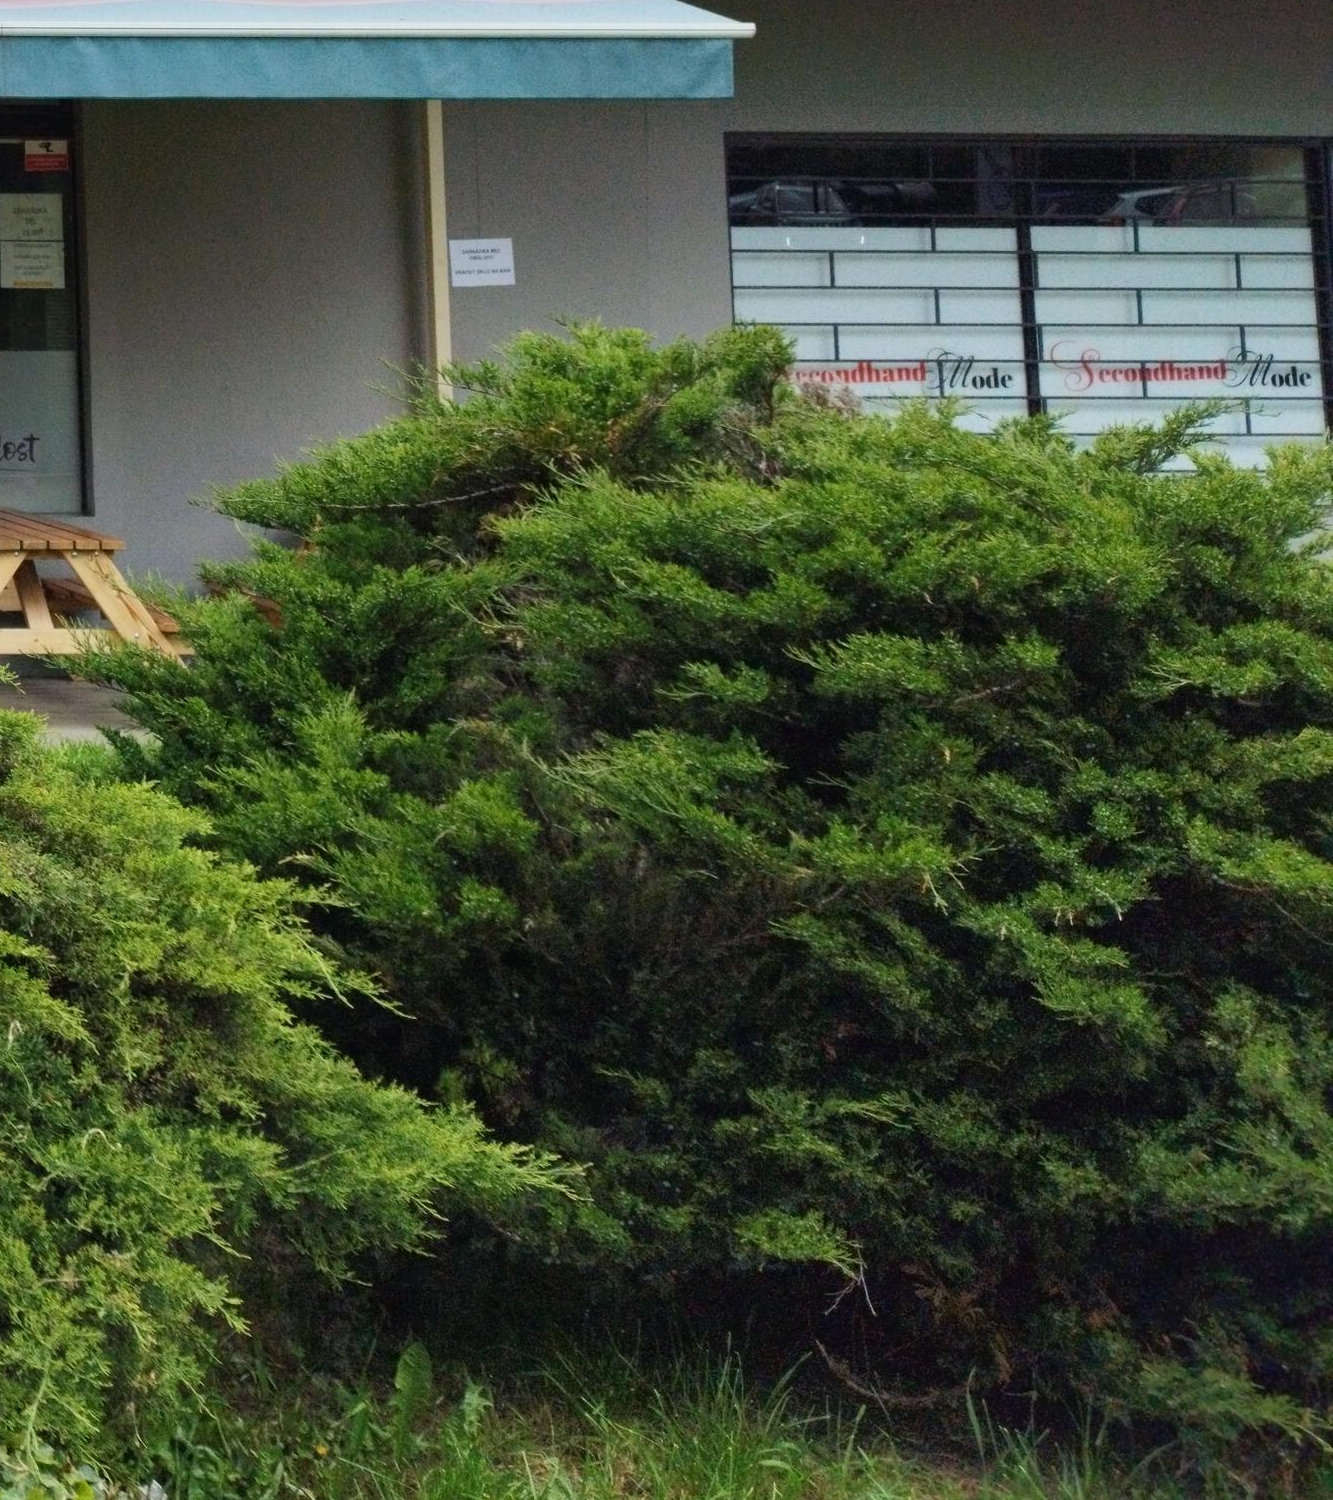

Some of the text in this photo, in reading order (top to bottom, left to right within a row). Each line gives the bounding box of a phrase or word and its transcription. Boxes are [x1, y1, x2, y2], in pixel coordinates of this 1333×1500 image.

[784, 348, 1014, 389] econdhand Mode
[1051, 340, 1312, 391] Secondhand Mode
